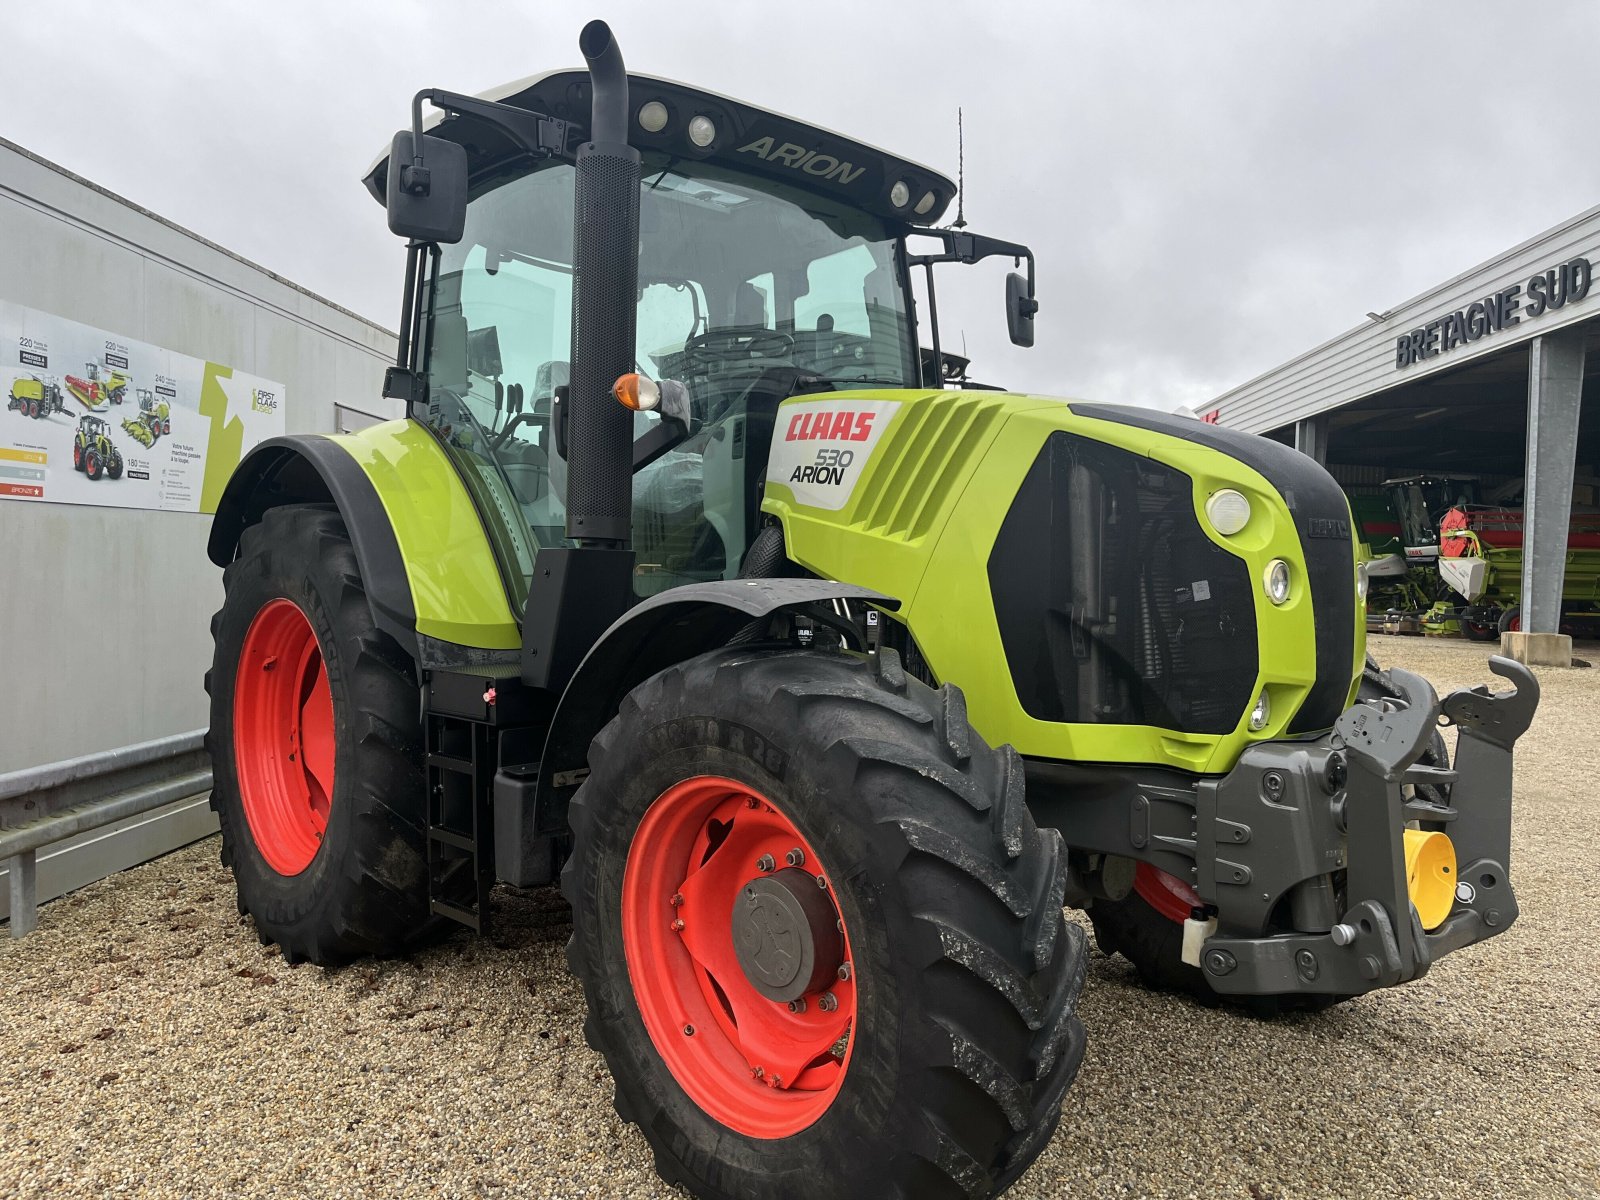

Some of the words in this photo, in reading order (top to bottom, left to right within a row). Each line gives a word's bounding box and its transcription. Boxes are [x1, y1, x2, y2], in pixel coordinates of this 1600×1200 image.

[736, 136, 866, 184] ARION
[1396, 285, 1521, 369] BRETAGNE
[1525, 257, 1592, 317] SUD
[19, 337, 33, 348] 220
[105, 340, 117, 351] 220
[257, 390, 275, 400] FIRST
[257, 397, 277, 409] CLAAS
[256, 404, 273, 415] USED
[785, 411, 877, 441] CLAAS
[127, 458, 138, 468] 180
[814, 449, 854, 468] 530
[790, 465, 845, 486] ARION
